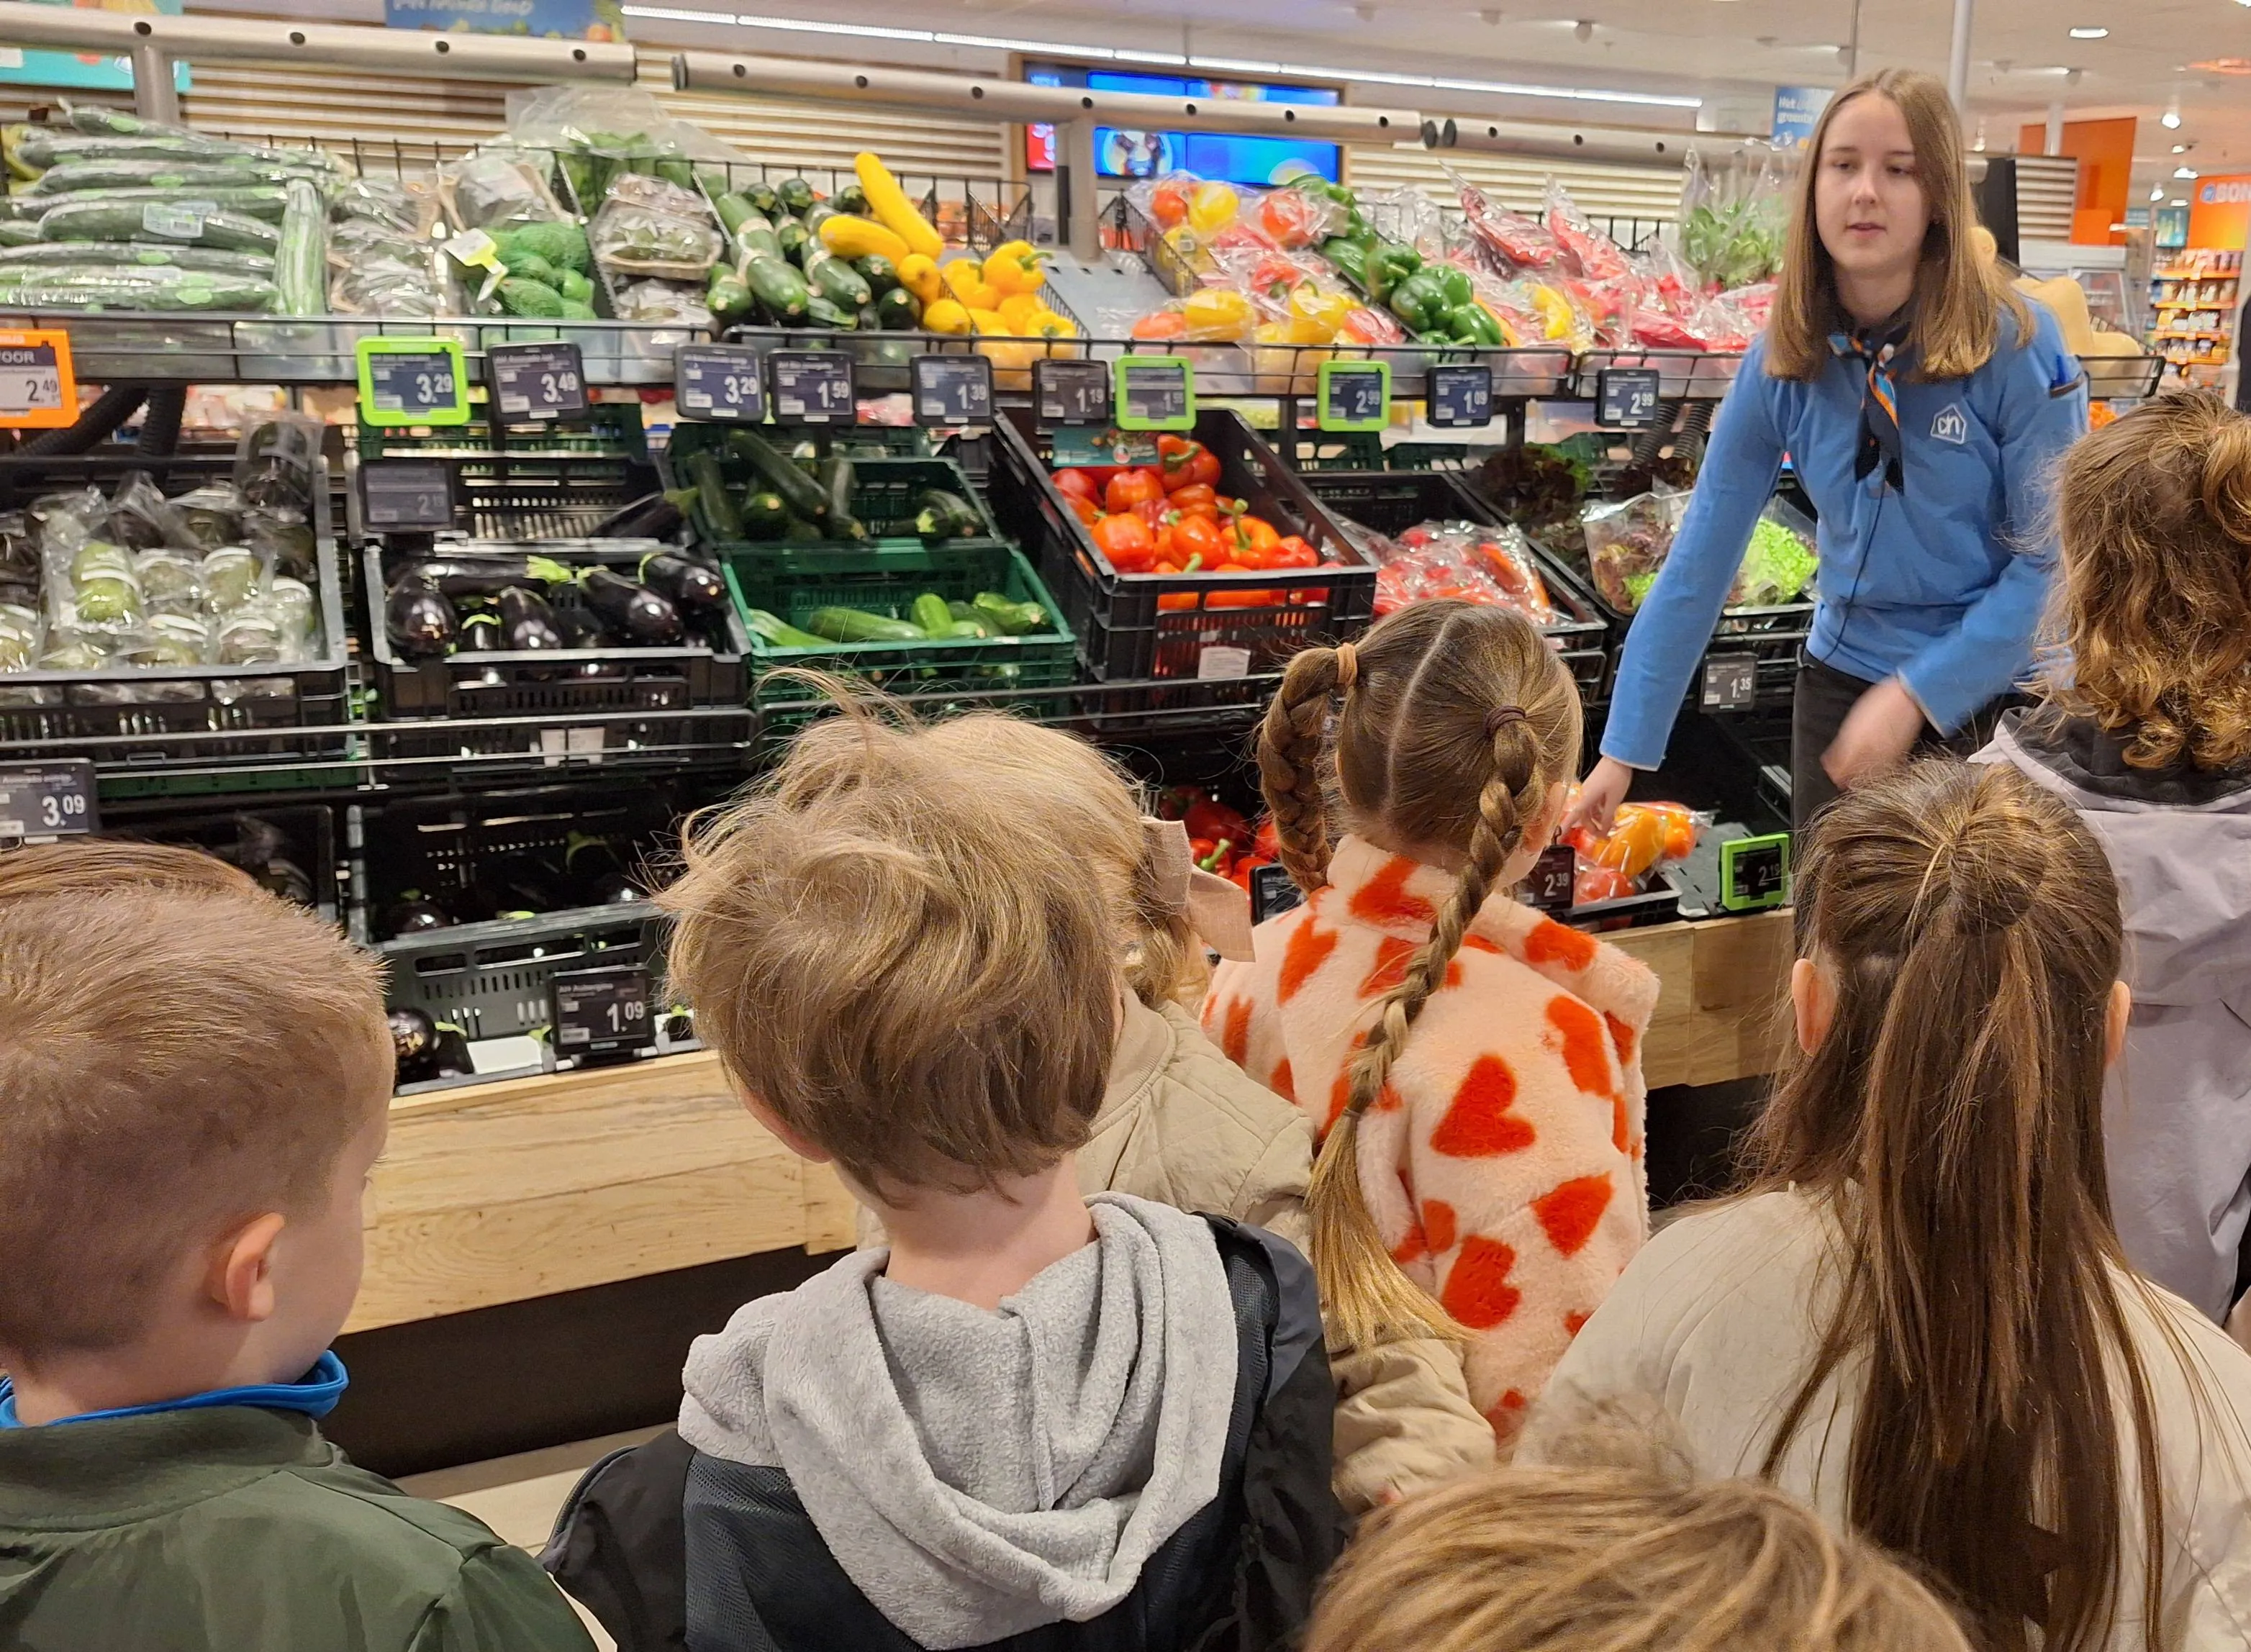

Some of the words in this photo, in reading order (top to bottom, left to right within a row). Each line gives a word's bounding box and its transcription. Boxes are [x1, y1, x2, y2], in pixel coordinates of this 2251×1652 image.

[0, 350, 35, 363] OOR
[416, 373, 453, 404] 3.29
[540, 371, 577, 403] 3.49
[724, 375, 758, 404] 3.29
[817, 380, 849, 408] 1.59
[956, 383, 987, 410] 1.39
[1076, 386, 1105, 413] 1.19
[1730, 677, 1752, 699] 1.35
[42, 794, 86, 827] 3.09
[606, 1001, 645, 1032] 1.09
